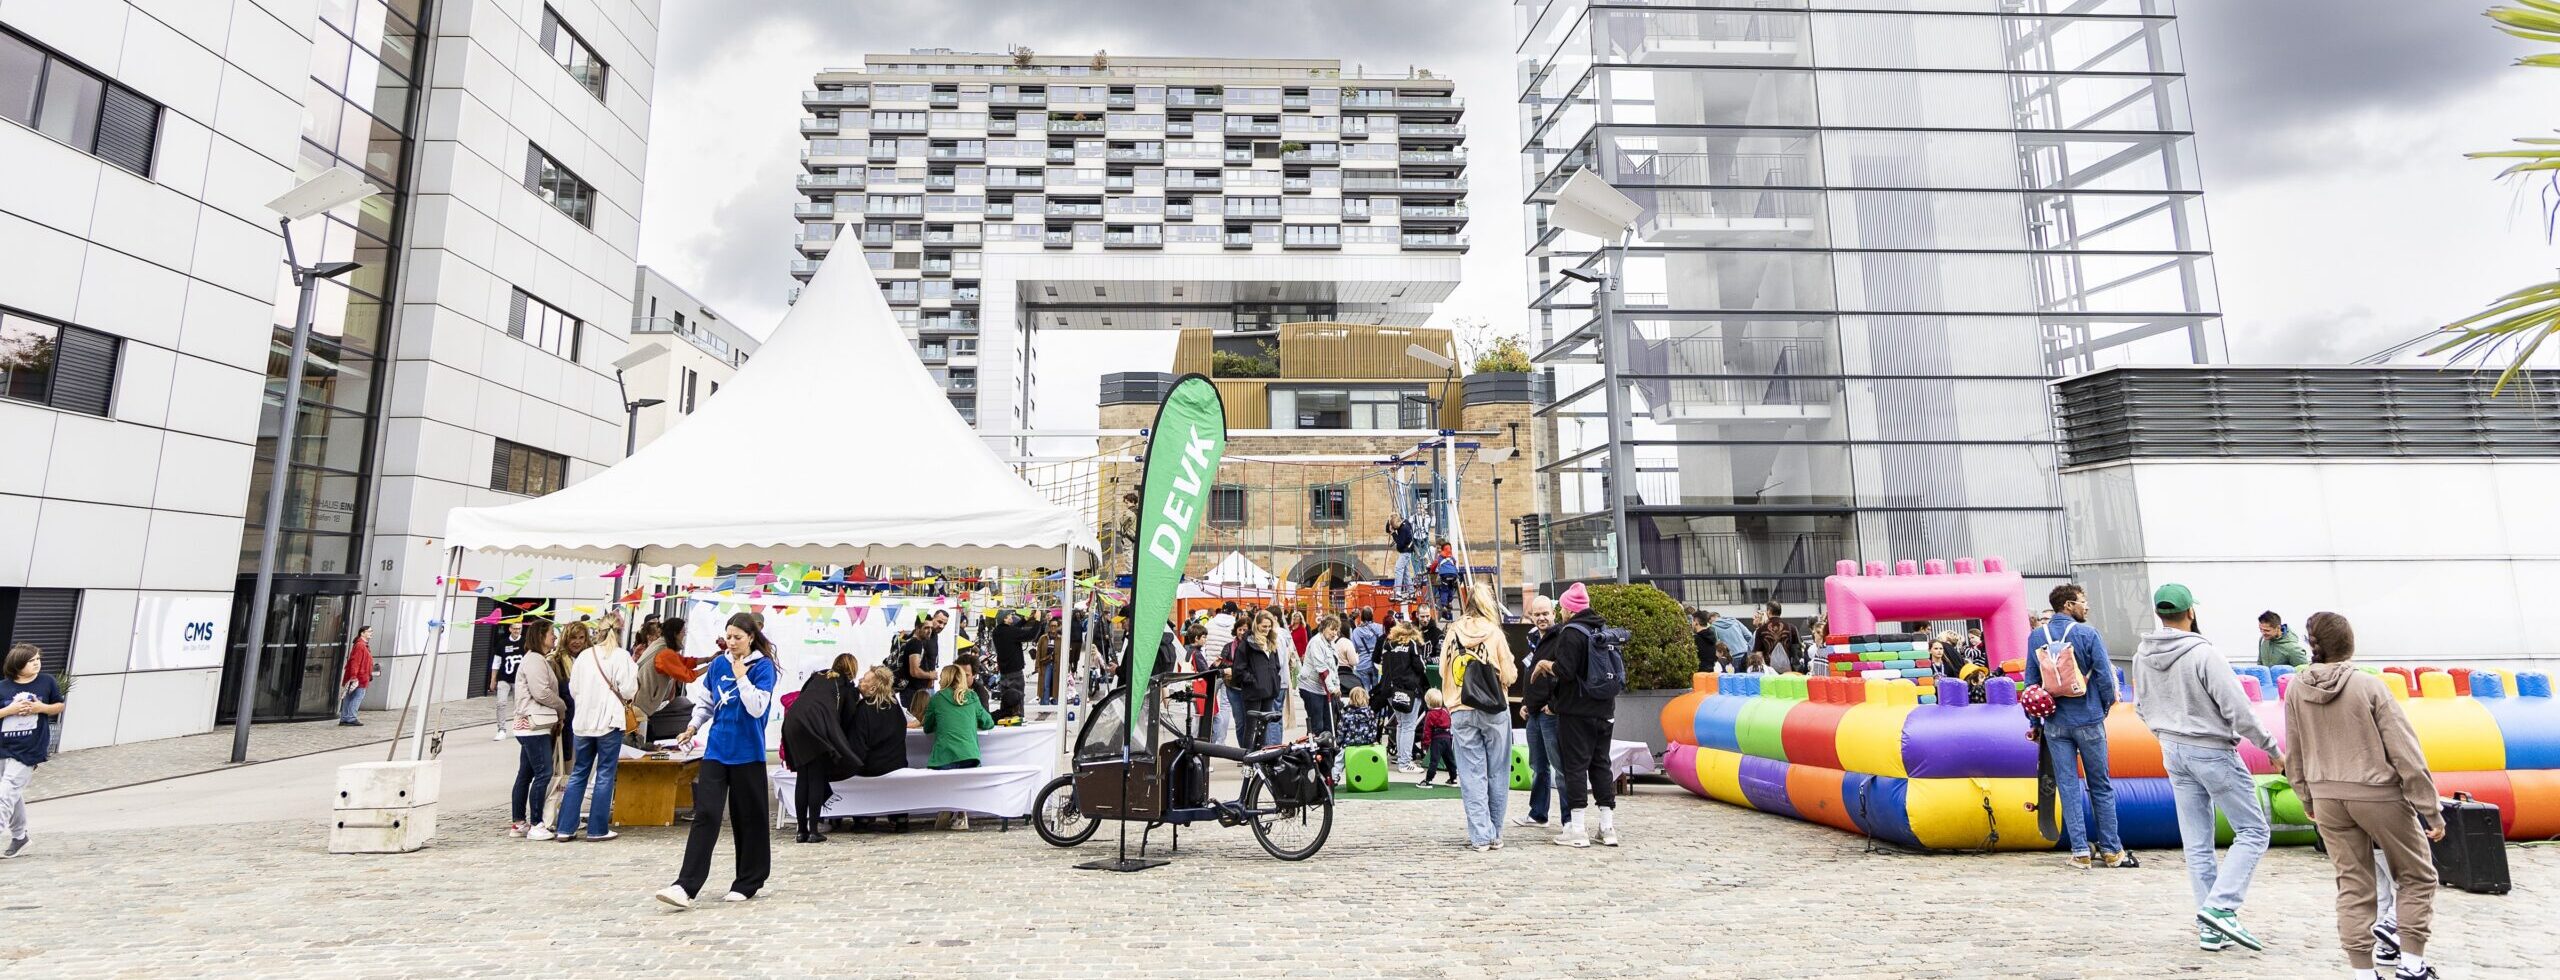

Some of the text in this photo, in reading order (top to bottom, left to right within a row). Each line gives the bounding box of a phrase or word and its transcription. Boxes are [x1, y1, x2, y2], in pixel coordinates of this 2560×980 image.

[1148, 423, 1216, 570] DEVK
[381, 559, 394, 571] 18
[184, 621, 214, 642] CMS
